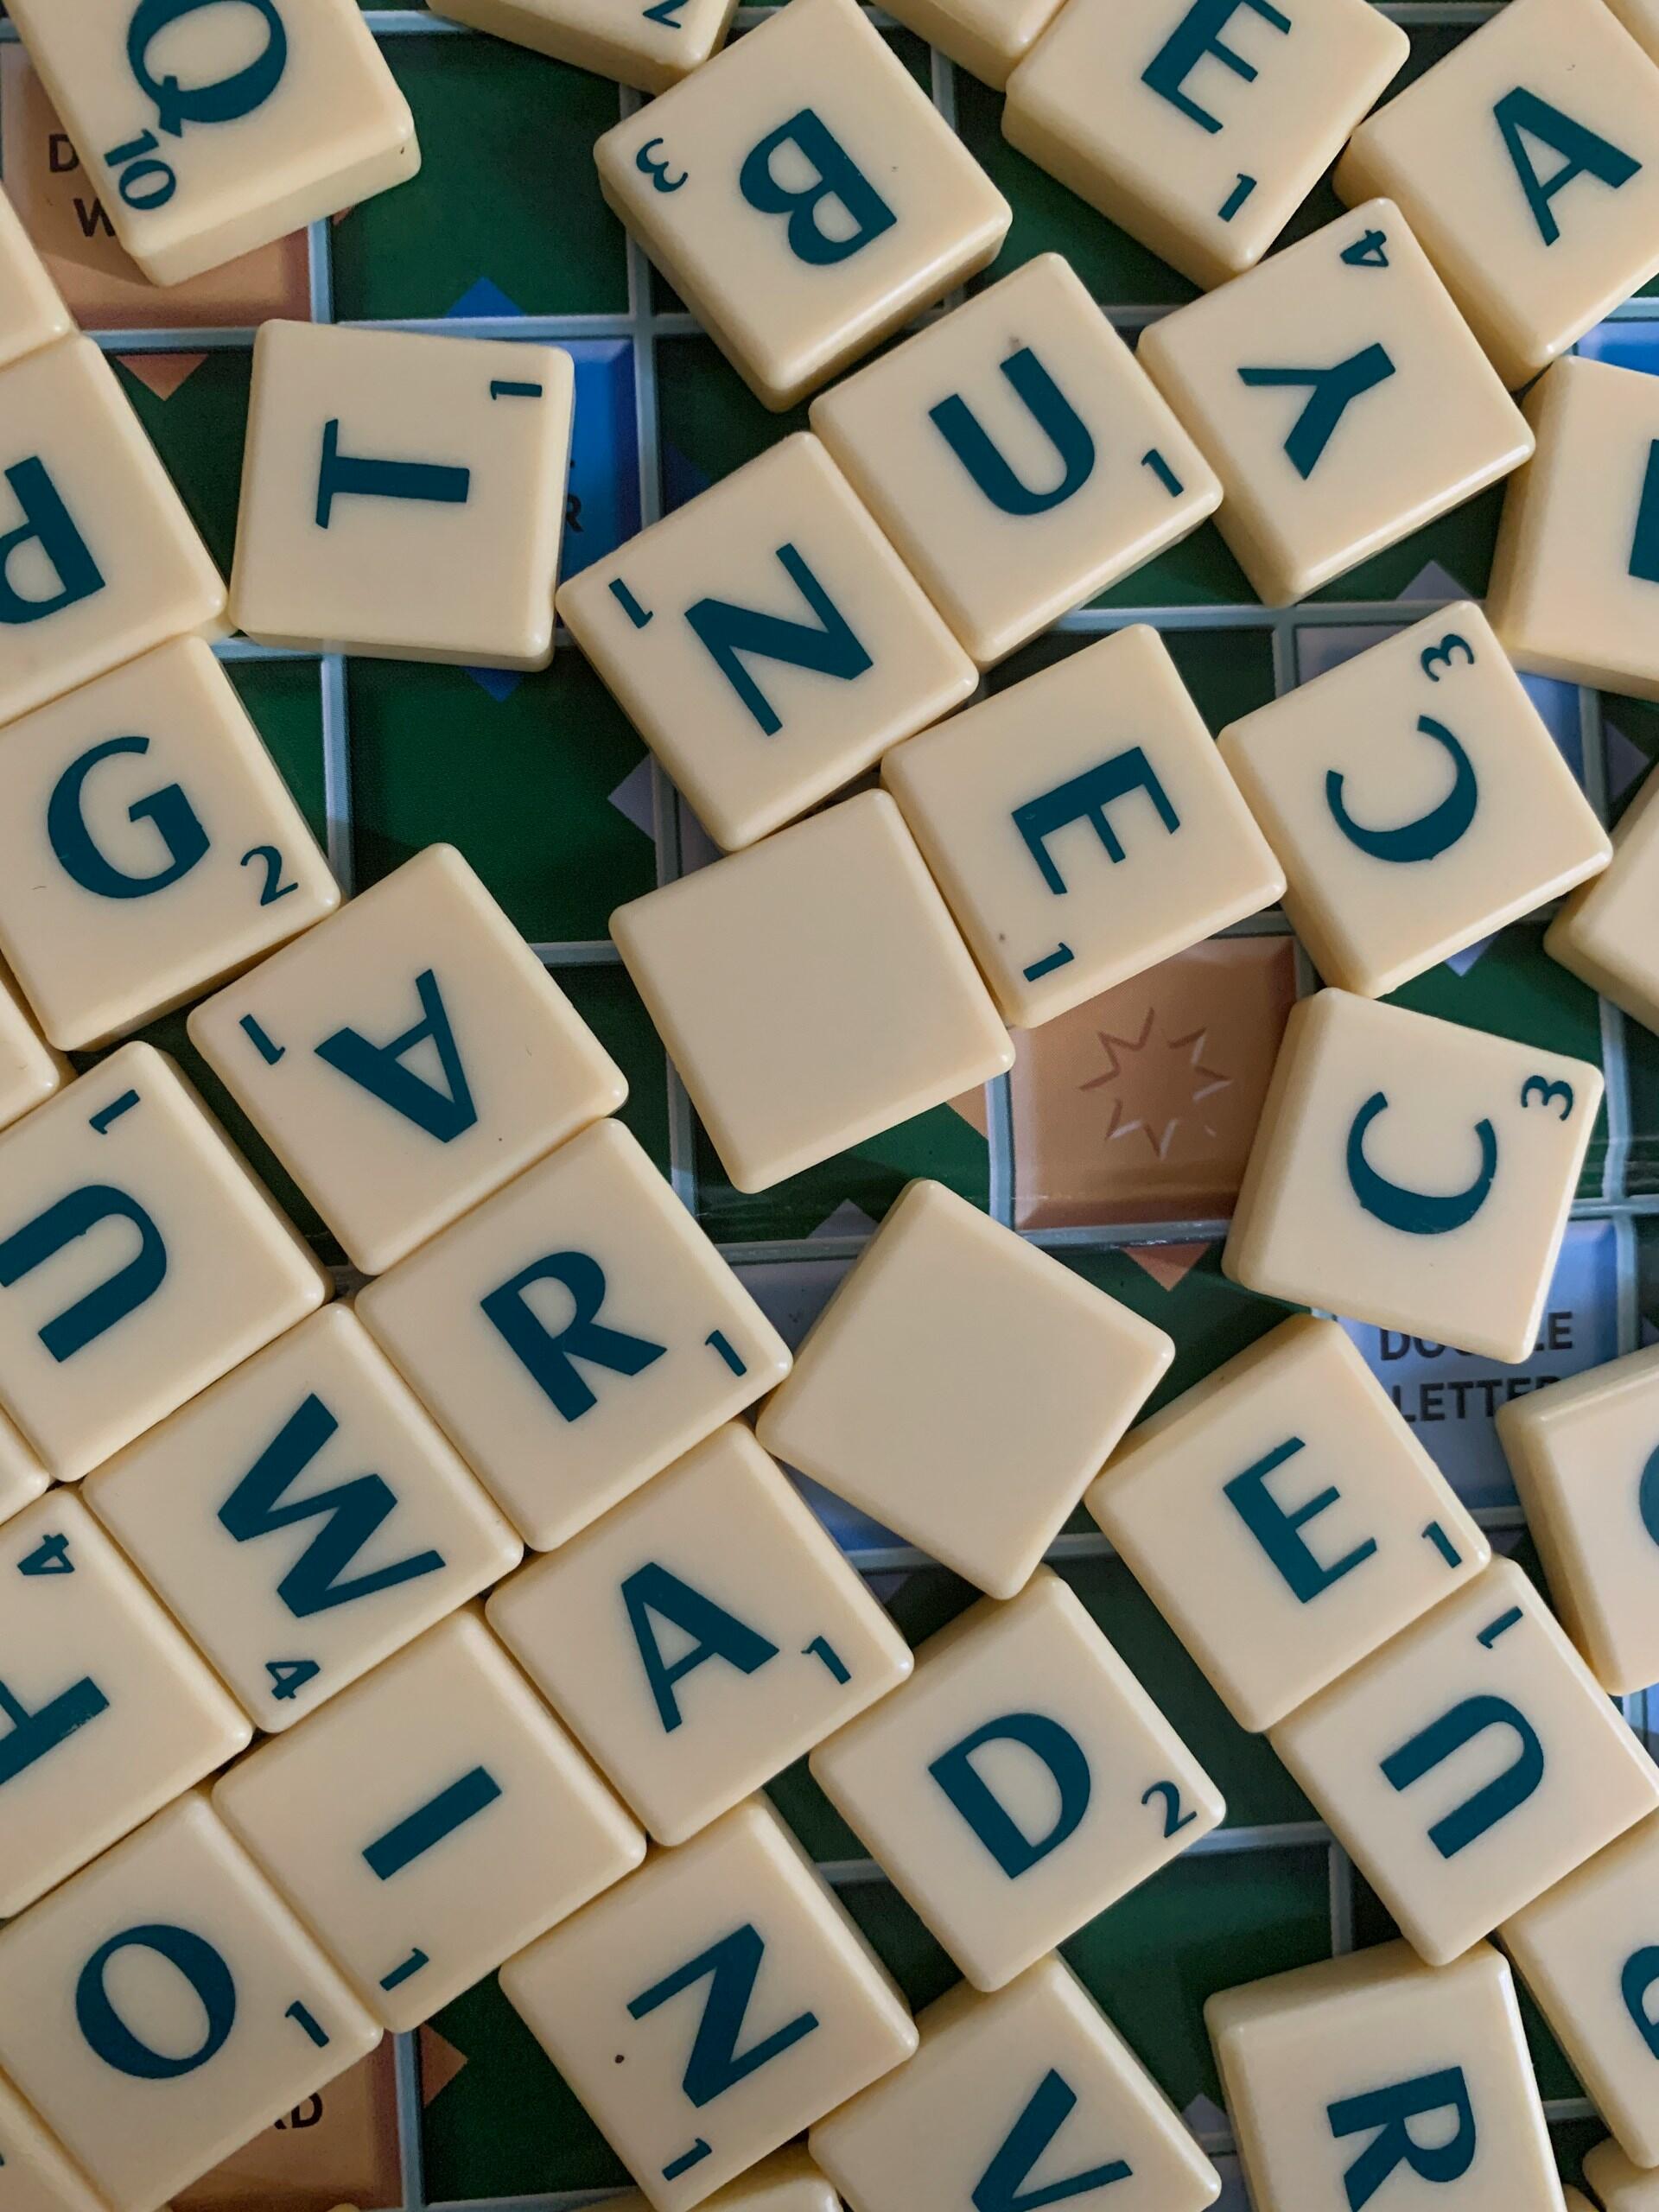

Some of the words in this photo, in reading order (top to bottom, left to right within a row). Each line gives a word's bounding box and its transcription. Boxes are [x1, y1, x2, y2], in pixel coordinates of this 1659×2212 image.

[125, 0, 288, 139] Q
[1140, 0, 1292, 135] E
[1217, 173, 1257, 222] 1
[104, 128, 177, 211] 10
[635, 137, 689, 194] 3
[739, 107, 898, 266] B
[1492, 86, 1643, 247] A
[928, 346, 1096, 517] U
[1141, 448, 1185, 498] 1
[1236, 342, 1396, 480] Y
[1339, 229, 1389, 268] 4
[315, 418, 471, 530] T
[489, 379, 543, 401] 1
[607, 577, 654, 629] 1
[683, 543, 874, 737] N
[47, 735, 211, 899] G
[239, 845, 299, 906] 2
[1010, 746, 1181, 895] E
[1325, 715, 1478, 864] C
[1420, 633, 1475, 683] 3
[238, 1014, 286, 1065] 1
[1022, 942, 1075, 982] 1
[313, 968, 479, 1144] A
[0, 1184, 168, 1363] U
[88, 1089, 141, 1135] 1
[1345, 1091, 1498, 1236] C
[1521, 1075, 1574, 1121] 3
[480, 1250, 668, 1423] R
[704, 1329, 747, 1377] 1
[16, 1533, 75, 1576] 4
[216, 1392, 447, 1618] W
[1222, 1436, 1377, 1605] E
[1421, 1521, 1462, 1569] 1
[264, 1659, 321, 1700] 4
[620, 1561, 780, 1734] A
[801, 1635, 852, 1685] 1
[927, 1712, 1091, 1880] D
[1141, 1780, 1198, 1839] 2
[1379, 1694, 1545, 1859] U
[1476, 1606, 1523, 1649] 1
[361, 1765, 503, 1881] I
[74, 1923, 238, 2081] O
[284, 1999, 330, 2048] 1
[378, 1947, 429, 1992] 1
[626, 1923, 820, 2109] N
[661, 2137, 713, 2182] 1
[970, 2068, 1134, 2212] V
[1325, 2065, 1477, 2212] R
